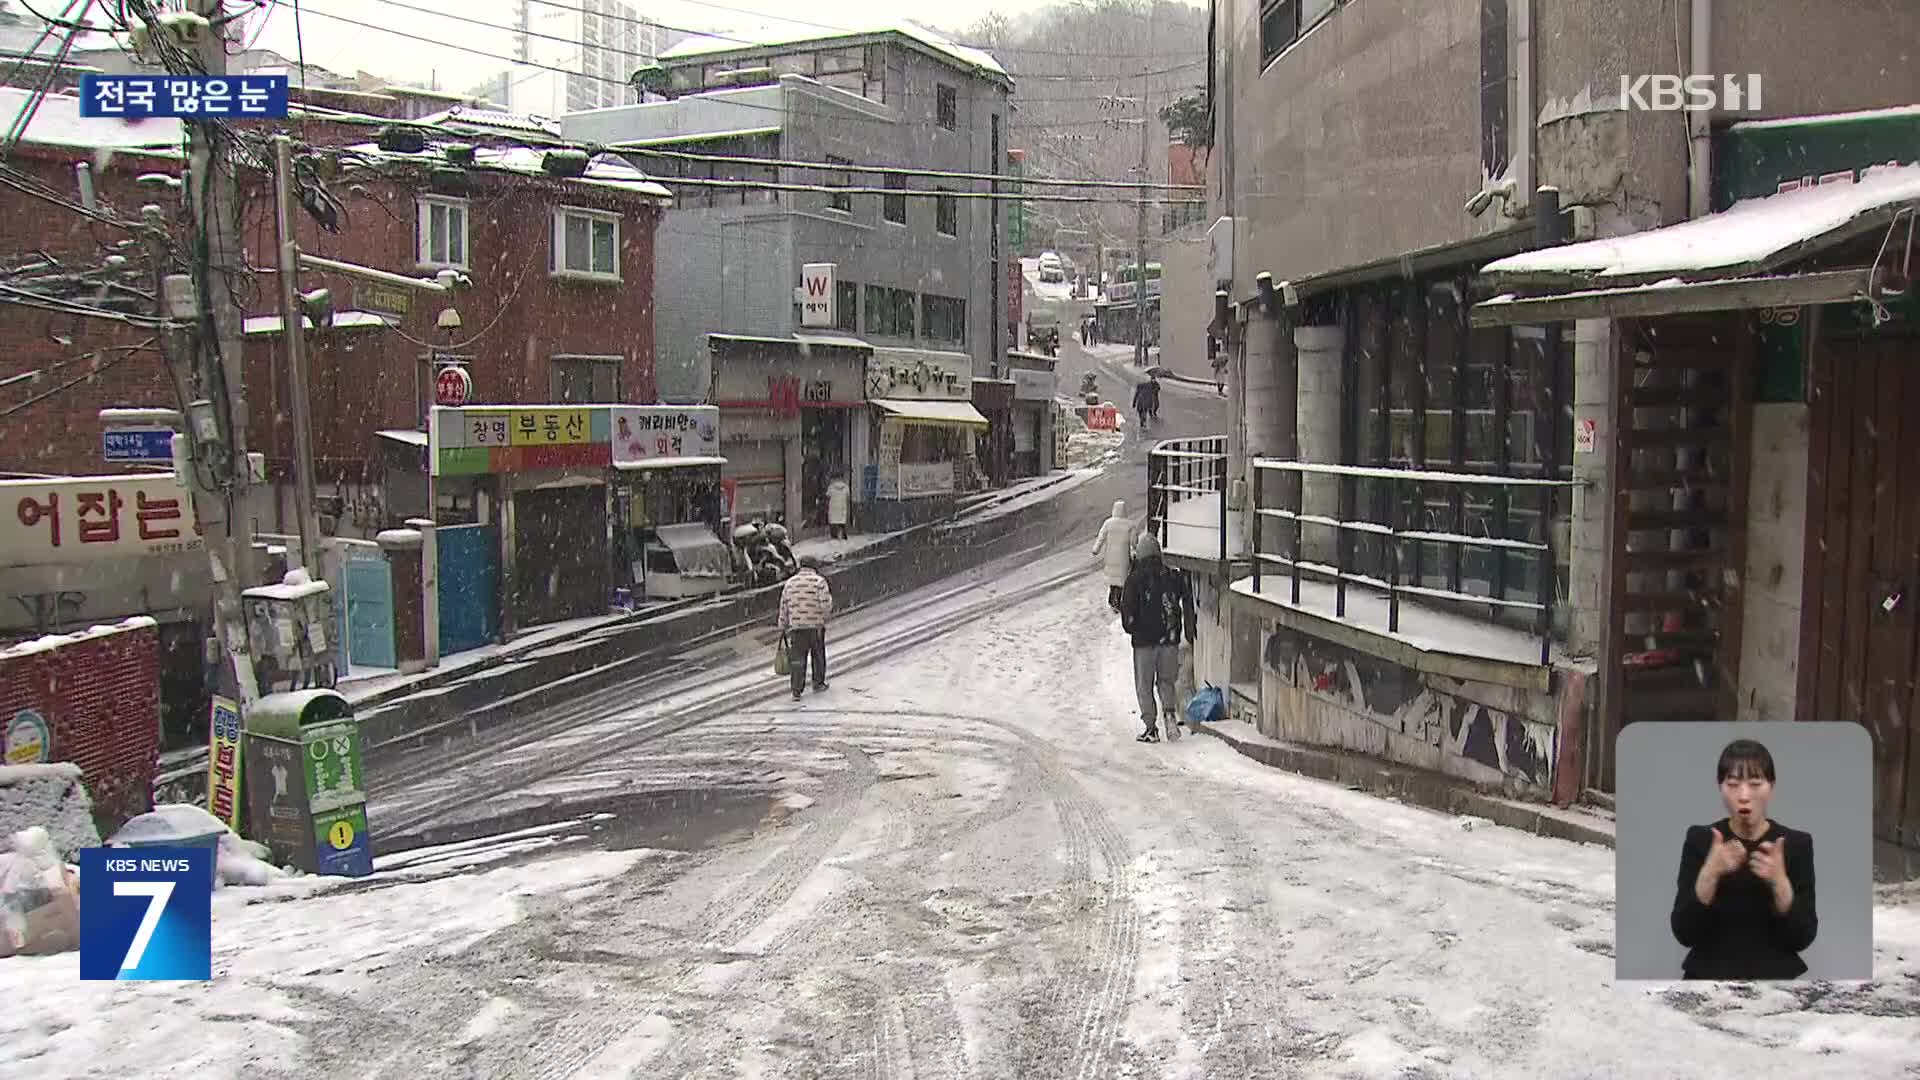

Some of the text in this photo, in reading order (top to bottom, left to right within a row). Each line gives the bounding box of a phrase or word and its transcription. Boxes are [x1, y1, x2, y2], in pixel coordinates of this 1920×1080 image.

[807, 276, 827, 297] W
[473, 414, 584, 442] 창명 부동산
